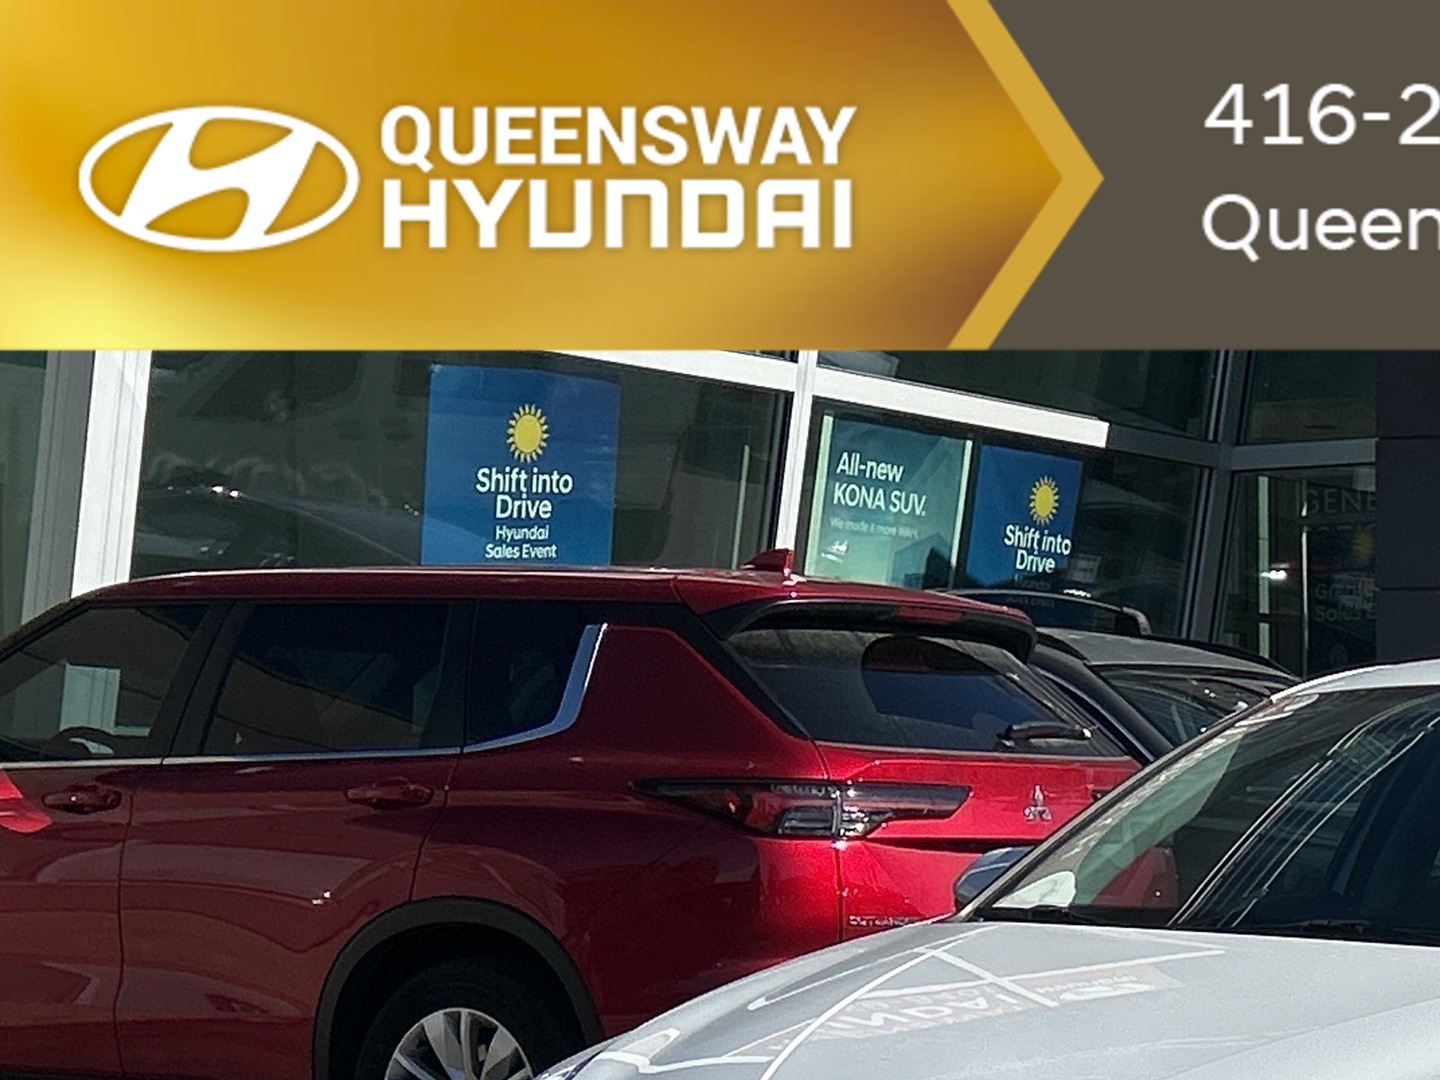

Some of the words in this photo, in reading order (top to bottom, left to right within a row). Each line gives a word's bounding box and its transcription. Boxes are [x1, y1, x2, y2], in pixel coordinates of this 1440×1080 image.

[476, 466, 527, 494] Shift
[532, 467, 573, 494] into
[836, 451, 904, 483] All-new
[495, 494, 552, 519] Drive
[833, 482, 885, 511] KONA
[495, 525, 549, 542] Hyundai
[1004, 525, 1041, 553] Shift
[1042, 530, 1072, 556] into
[485, 543, 520, 559] Sales
[522, 543, 557, 559] Event
[1015, 550, 1056, 574] Drive
